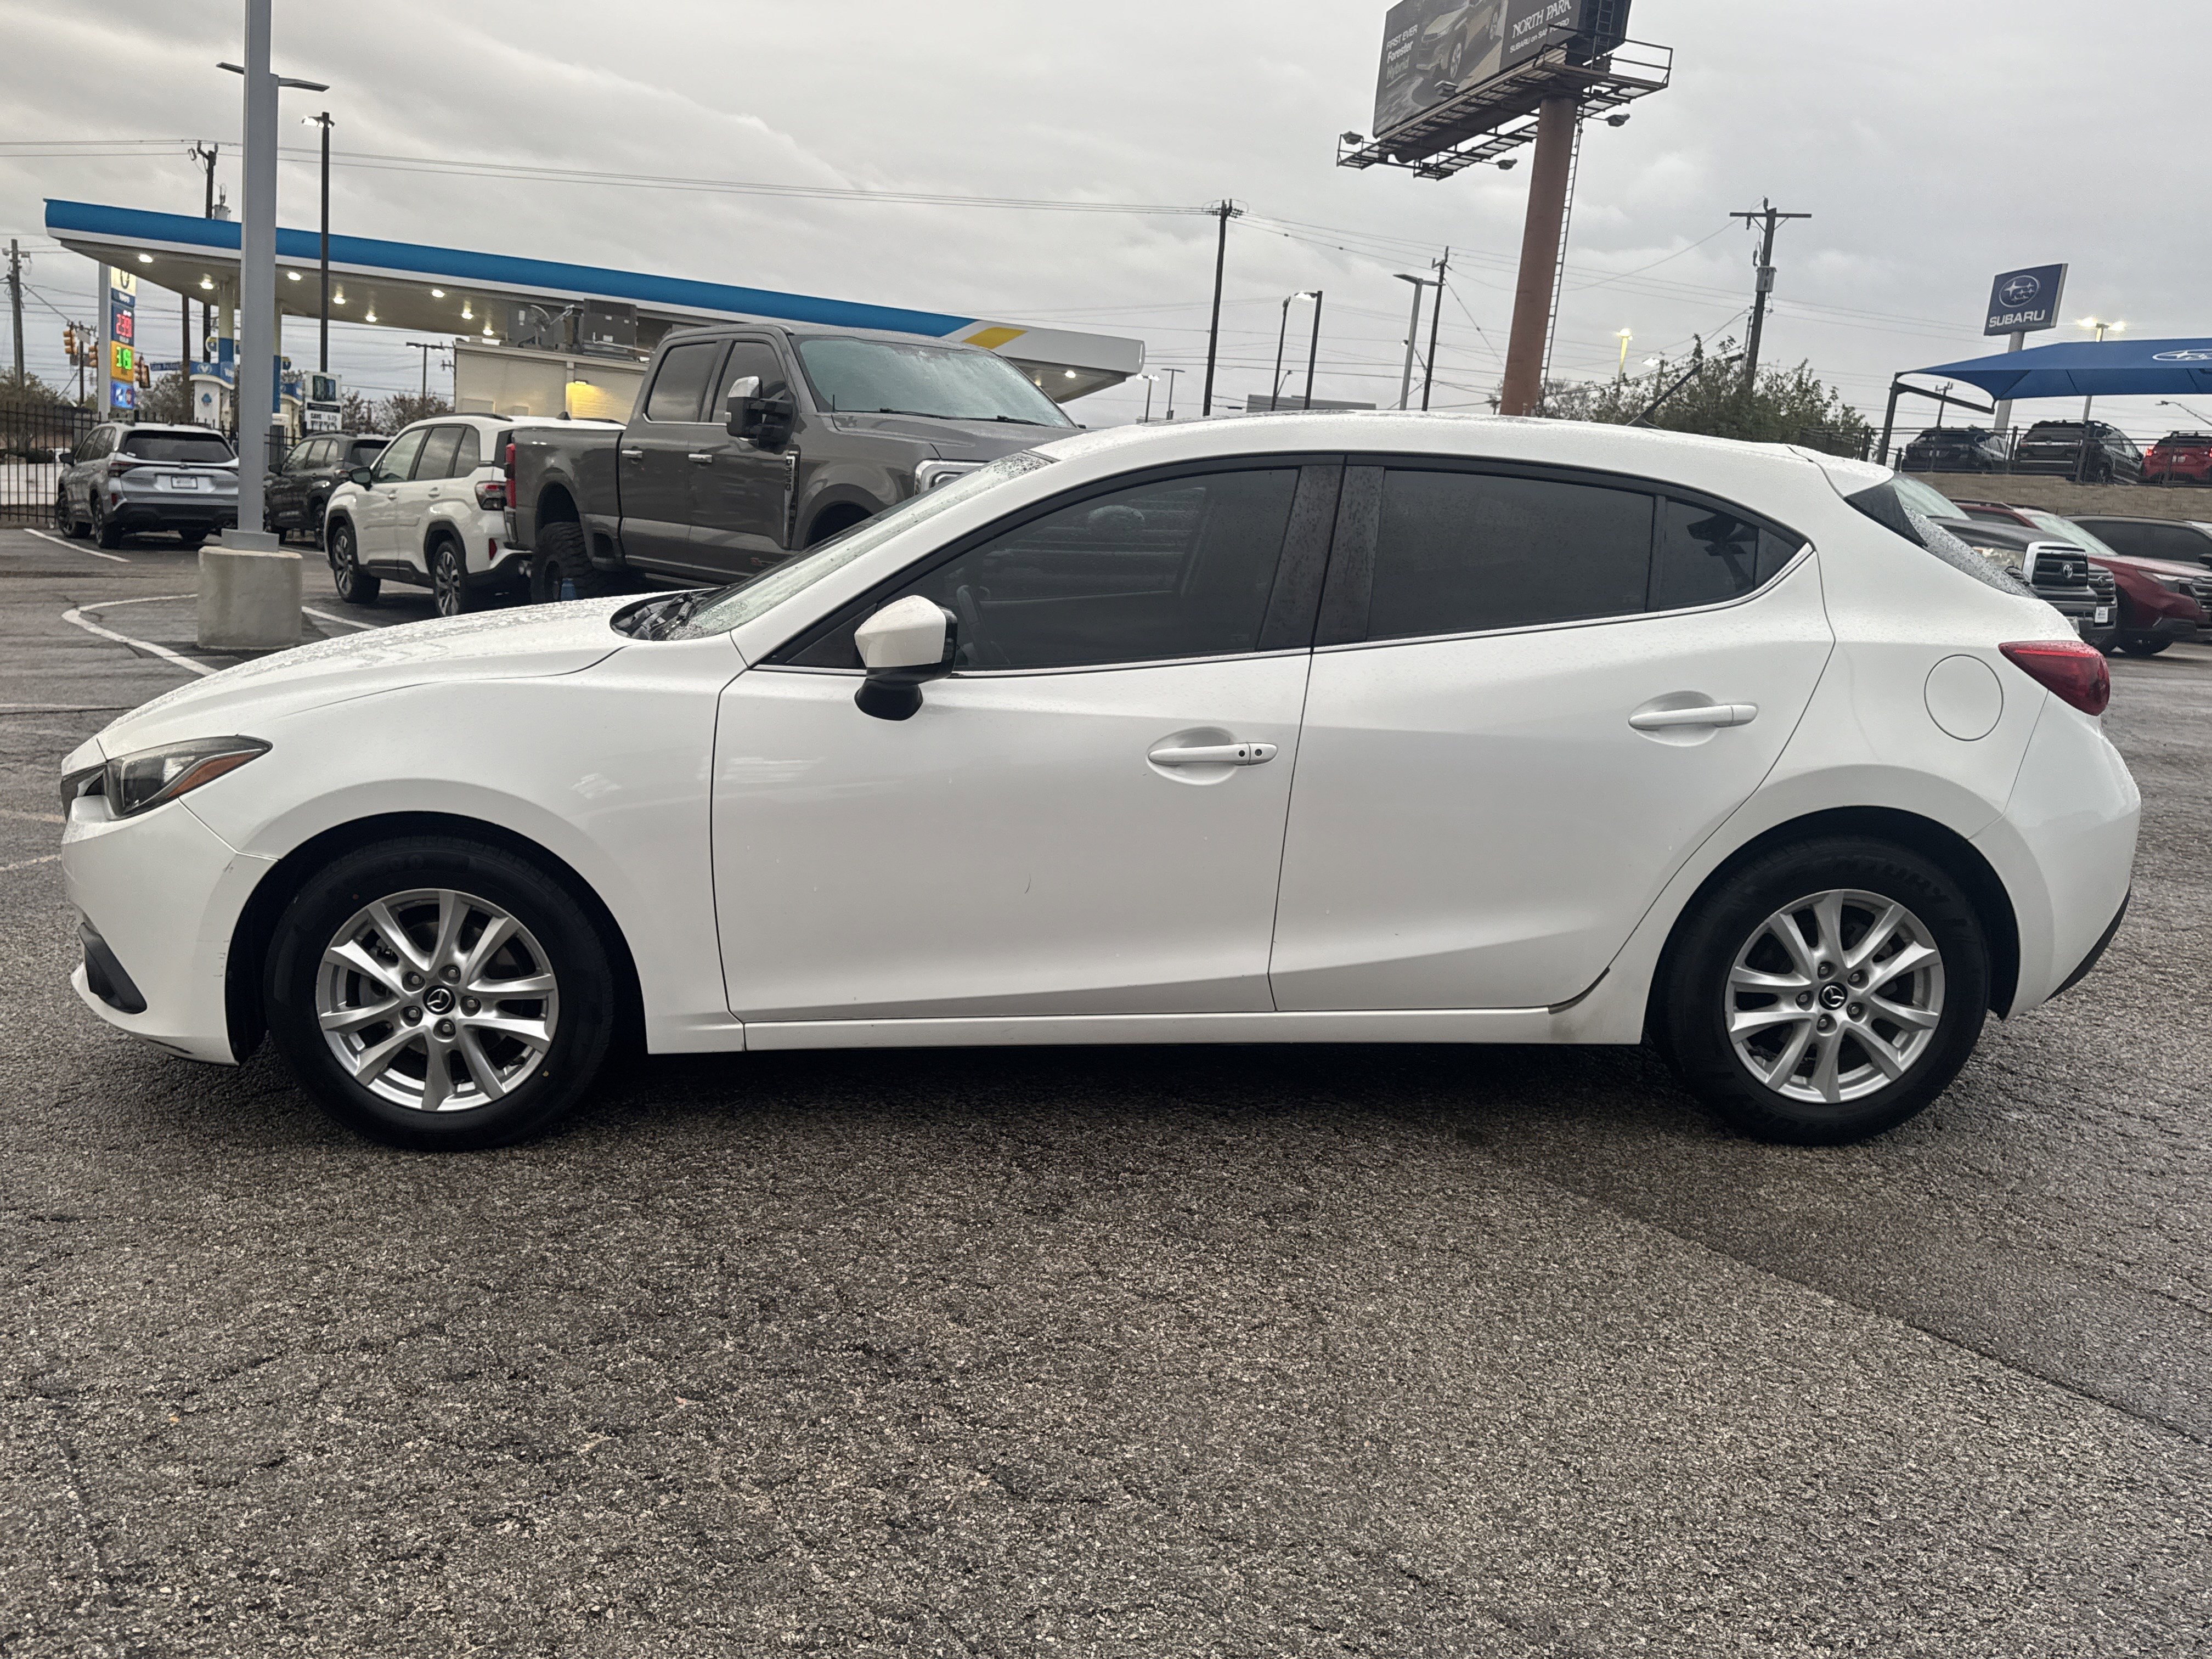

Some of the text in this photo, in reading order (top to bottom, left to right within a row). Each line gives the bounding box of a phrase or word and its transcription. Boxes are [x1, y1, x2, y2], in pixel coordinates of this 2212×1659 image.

[1512, 0, 1572, 38] NORTH PARK
[1386, 25, 1418, 51] FIRST EVER
[1510, 37, 1531, 53] SUBARU
[1387, 41, 1414, 64] Forester
[1989, 309, 2045, 328] SUBARU
